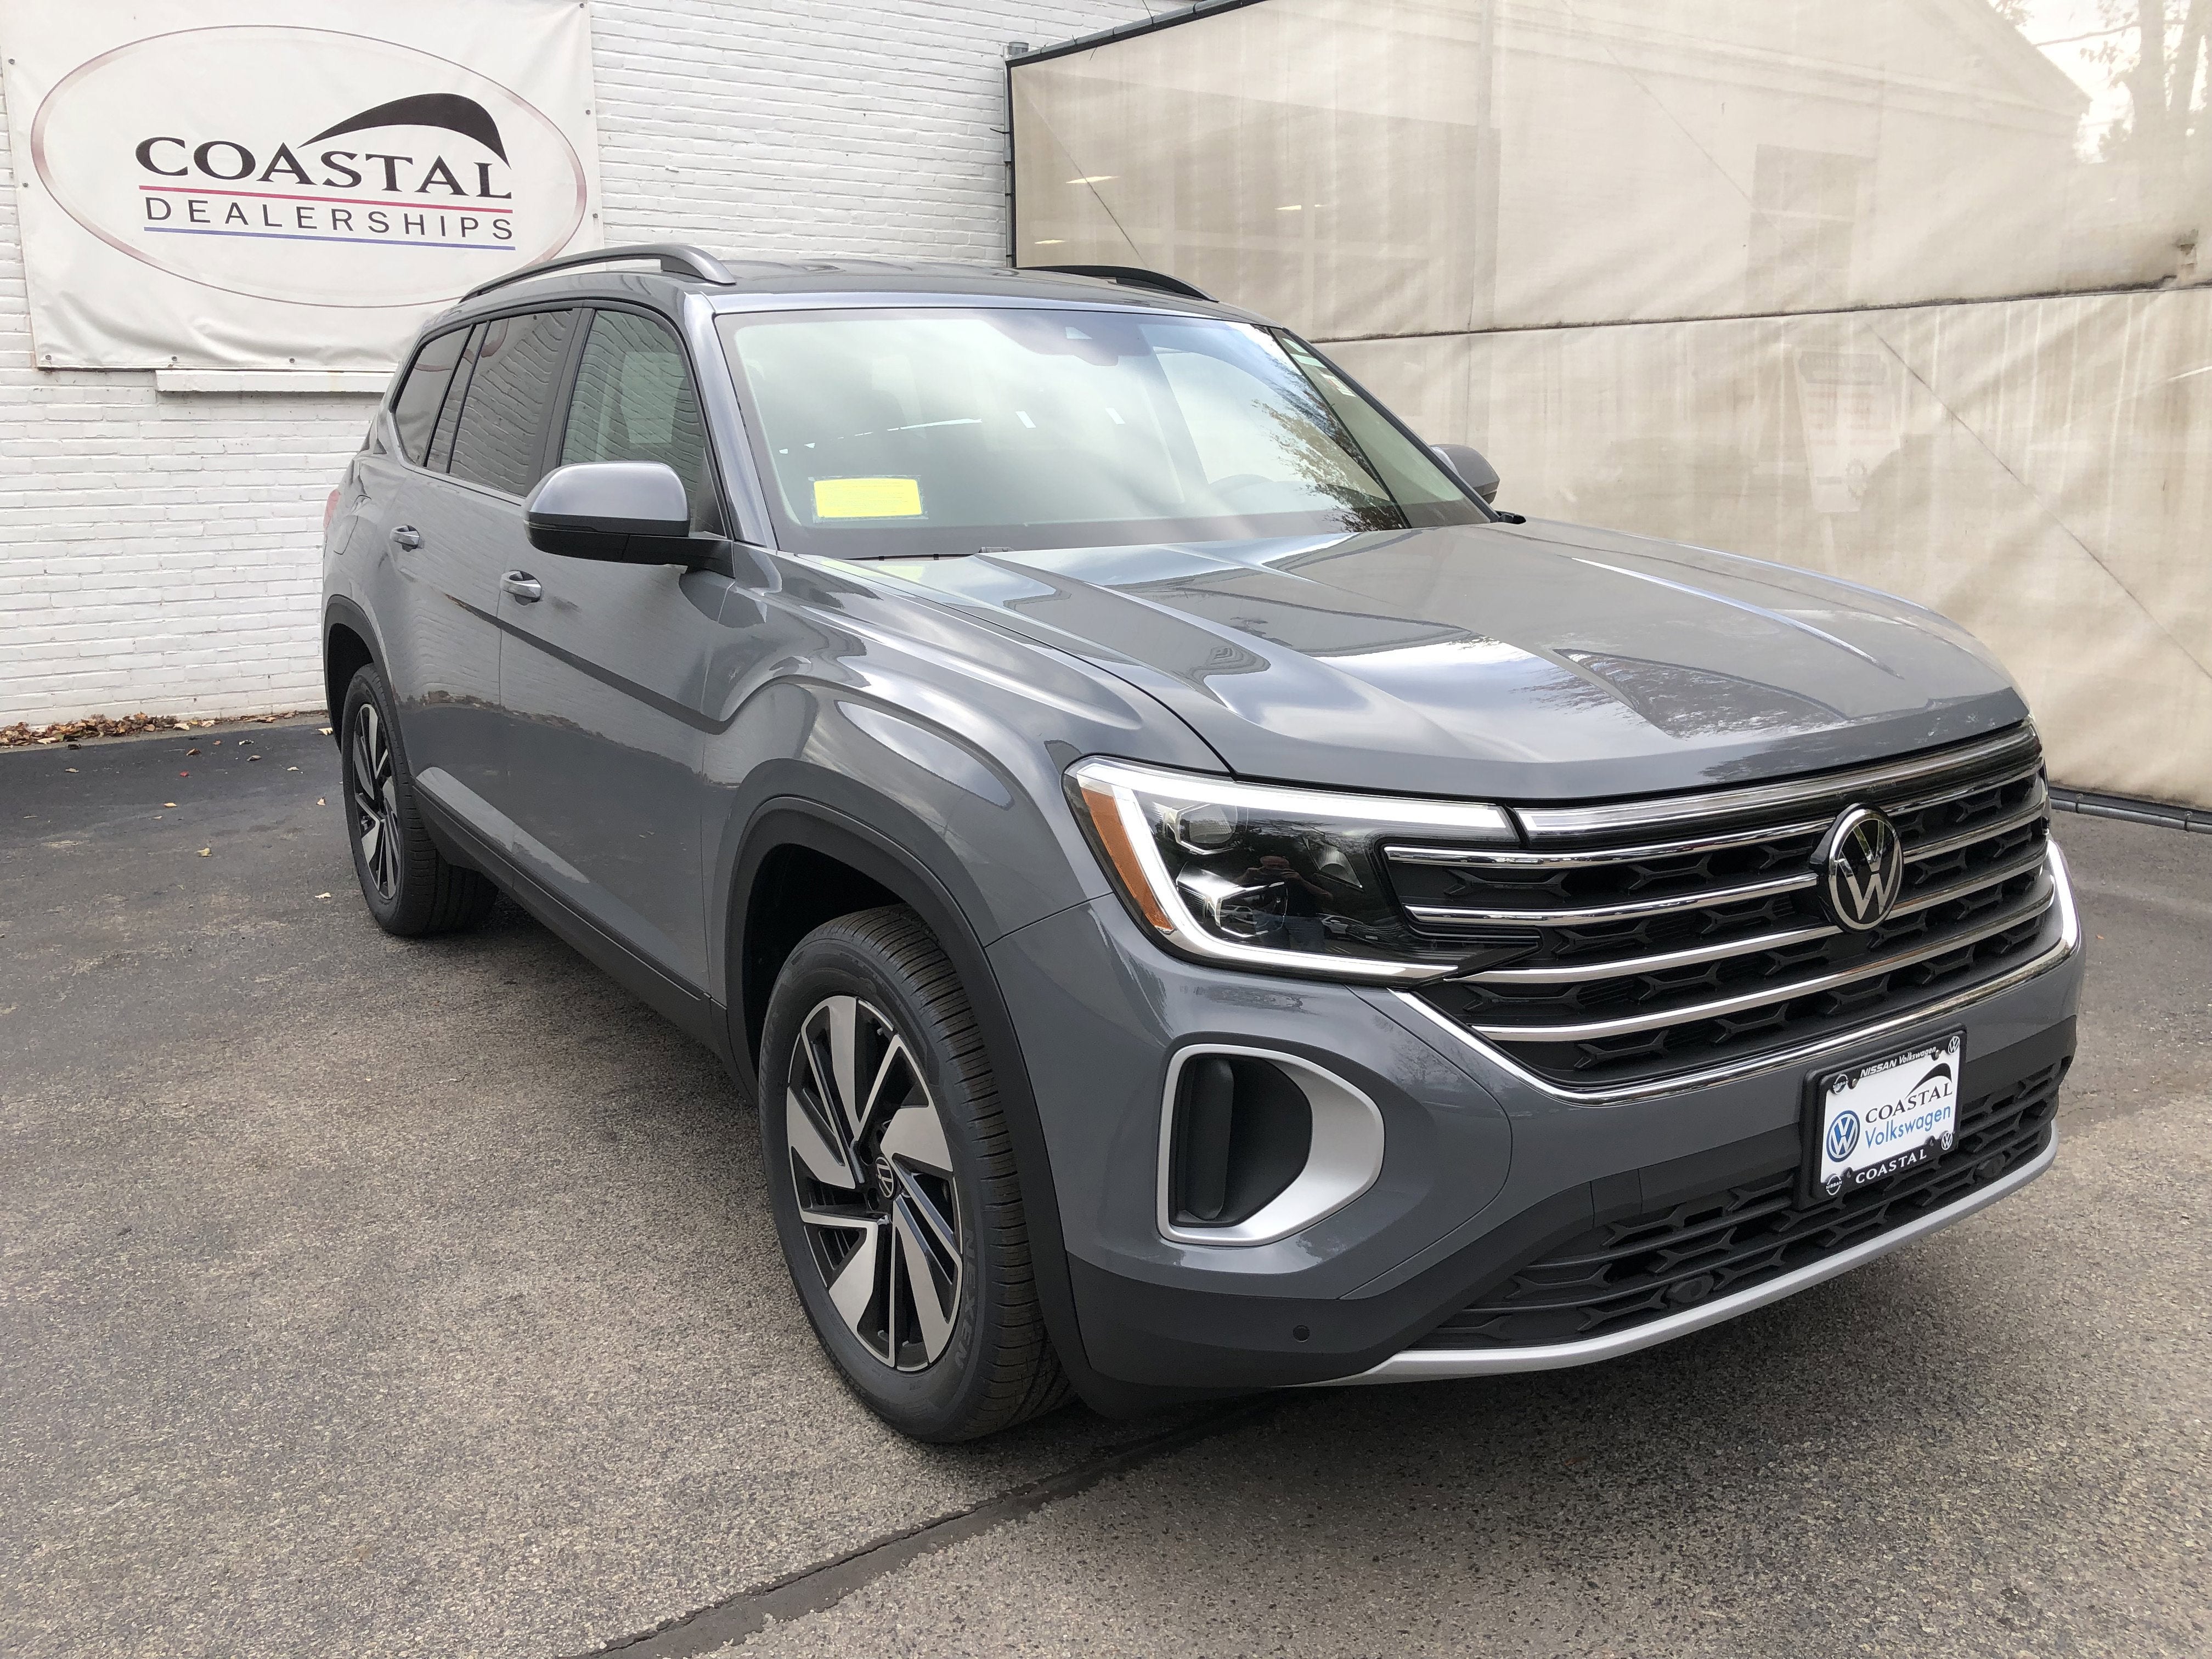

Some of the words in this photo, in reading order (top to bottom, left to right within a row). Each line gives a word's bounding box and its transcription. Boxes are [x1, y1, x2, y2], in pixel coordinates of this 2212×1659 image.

[136, 137, 512, 199] COASTAL
[145, 196, 513, 240] DEALERSHIPS
[1860, 1059, 1897, 1077] NISSAN
[1899, 1046, 1937, 1064] Volkswagen
[1865, 1084, 1953, 1123] COASTAL
[1865, 1105, 1950, 1149] Volkswagen
[1855, 1149, 1927, 1183] COASTAL
